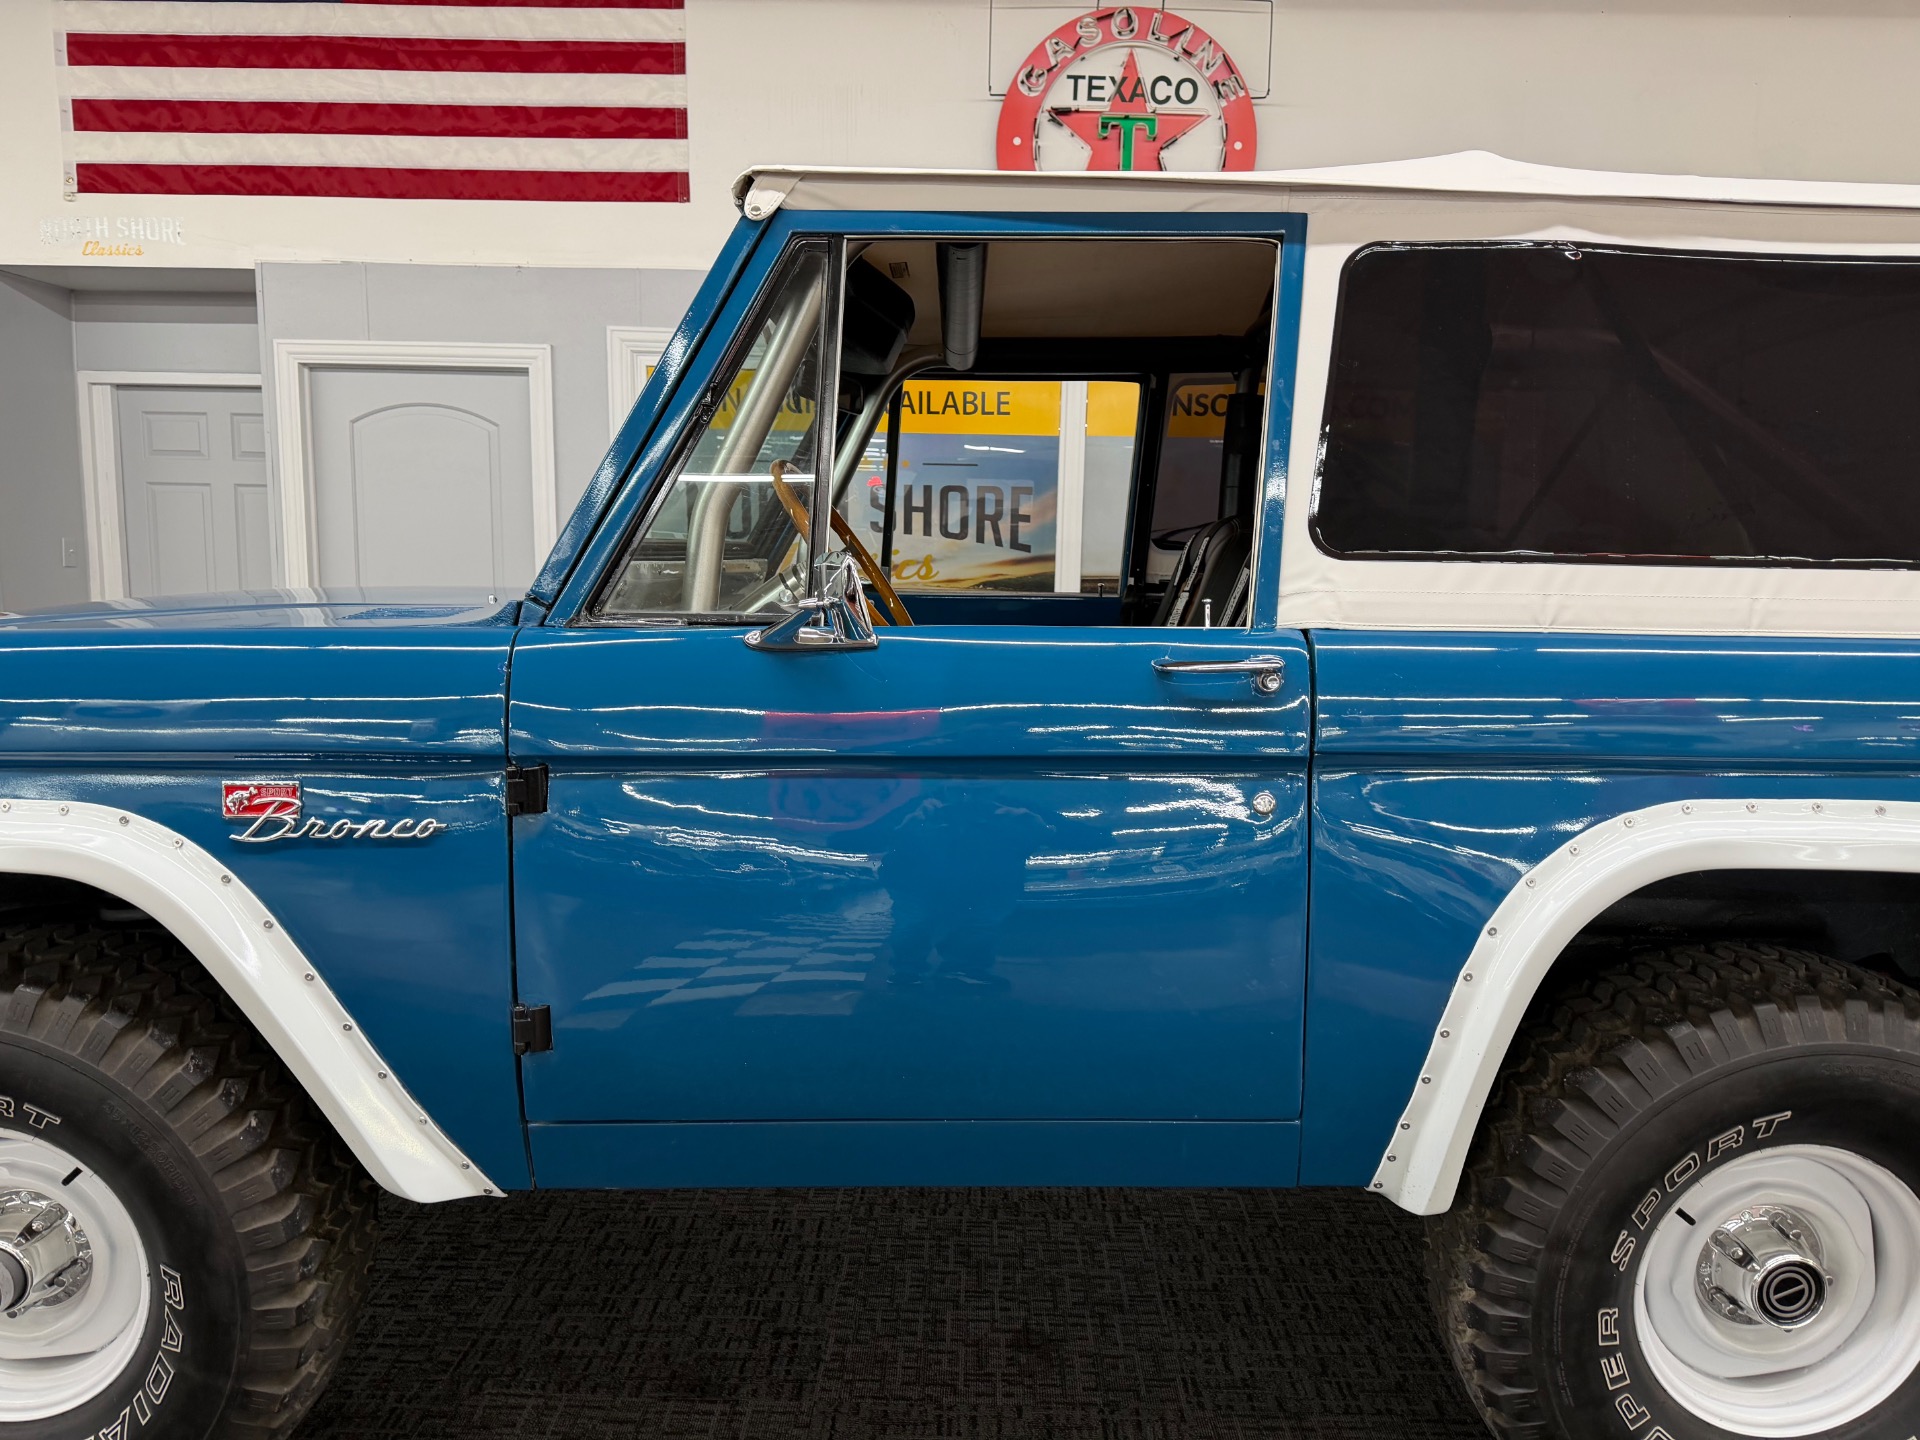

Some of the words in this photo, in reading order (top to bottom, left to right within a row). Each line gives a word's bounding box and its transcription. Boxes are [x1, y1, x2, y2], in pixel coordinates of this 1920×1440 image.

[1017, 7, 1246, 107] GASOLINE
[1067, 75, 1199, 105] TEXACO
[116, 216, 187, 246] SHORE
[82, 241, 145, 256] Classics
[885, 391, 1010, 416] AILABLE
[260, 787, 295, 797] SPORT
[229, 797, 448, 842] Bronco
[1611, 1110, 1792, 1271] SPORT
[84, 1263, 185, 1440] RADIA
